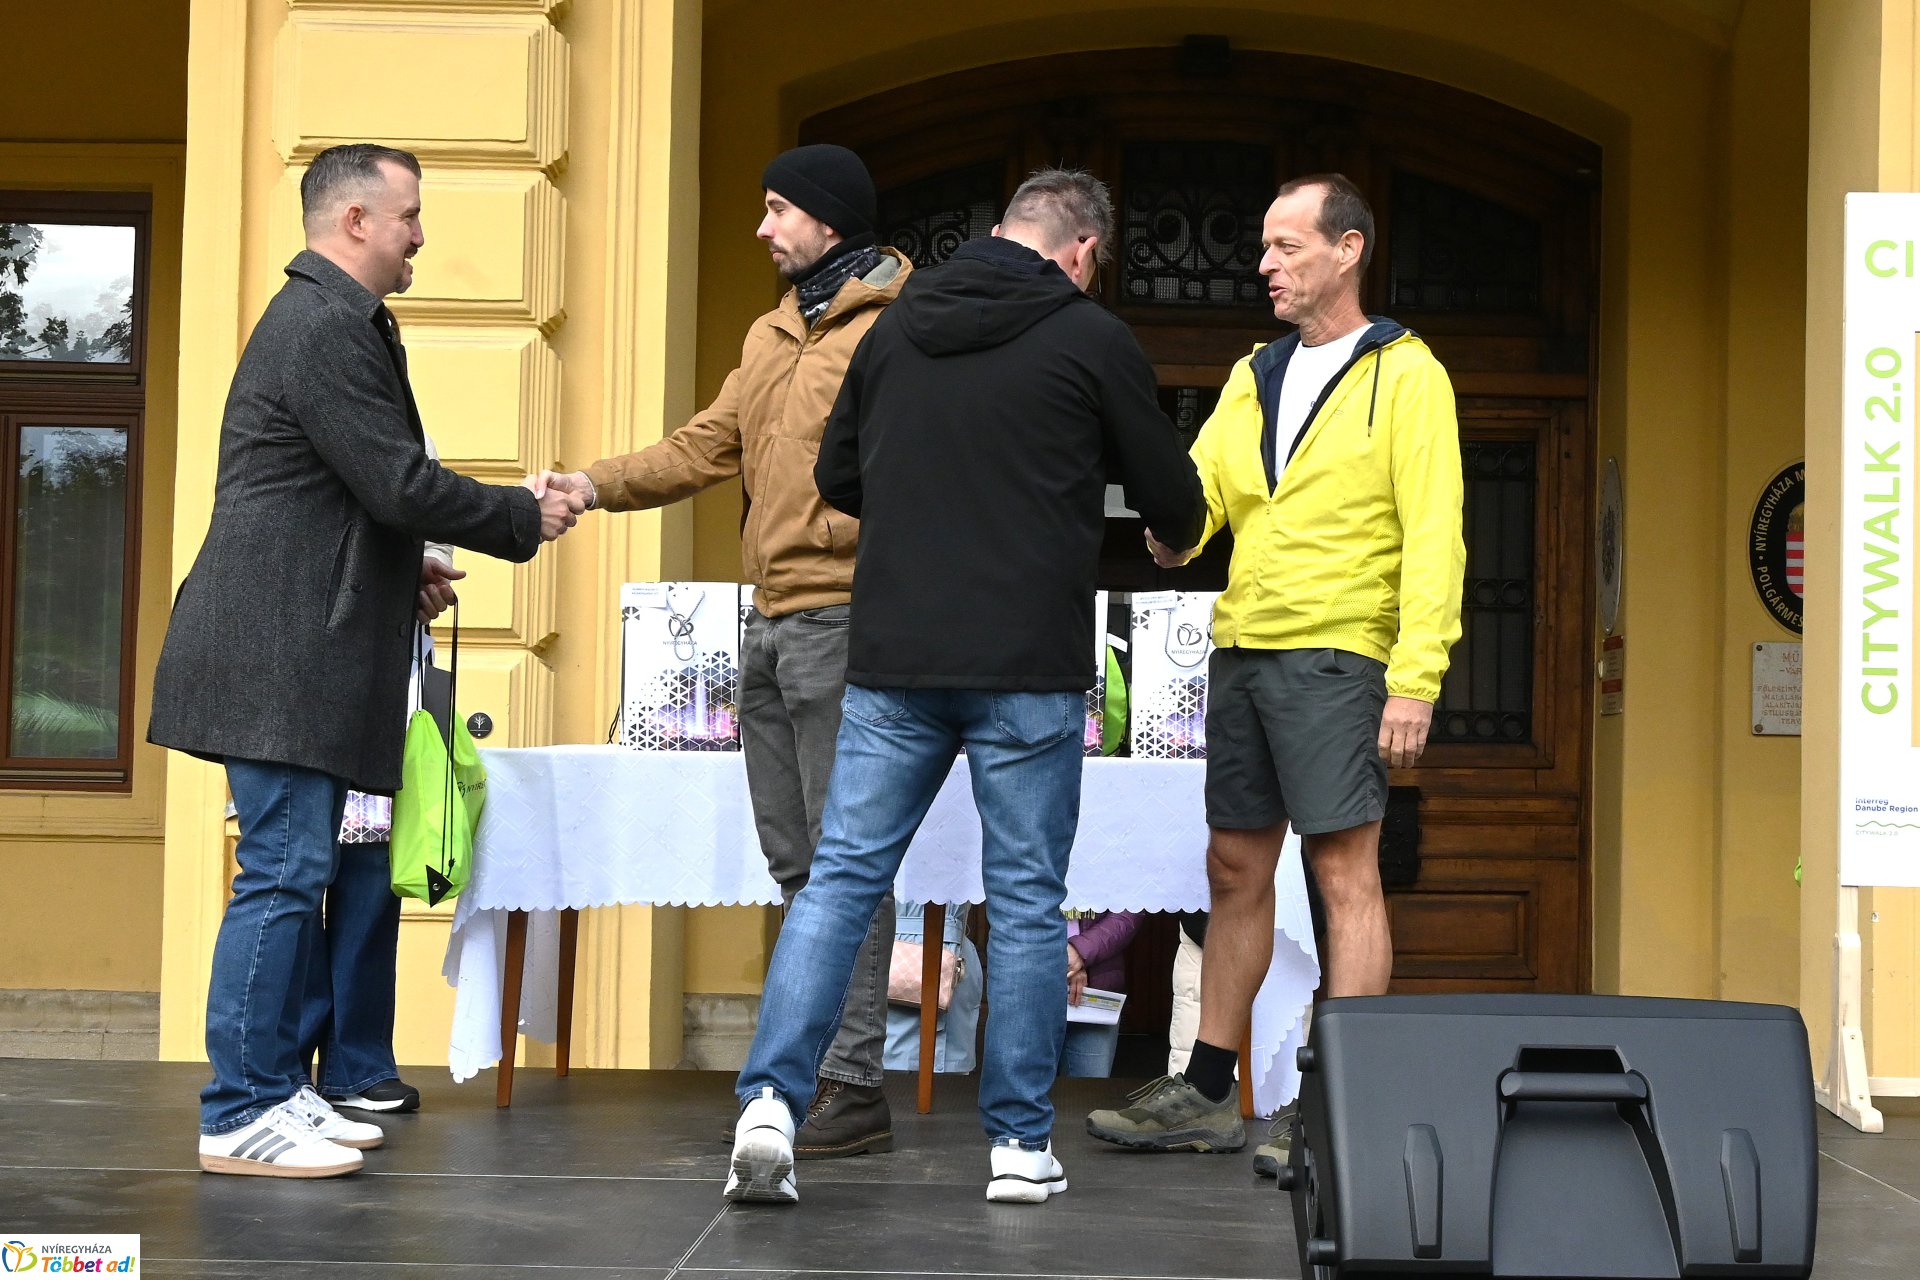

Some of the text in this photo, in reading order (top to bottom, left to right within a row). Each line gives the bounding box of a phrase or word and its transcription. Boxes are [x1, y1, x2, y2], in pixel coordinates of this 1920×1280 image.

[1754, 476, 1795, 551] NYÍREGYHÁZA
[1861, 347, 1902, 715] CITYWALK 2.0
[1855, 804, 1919, 814] Danube Region
